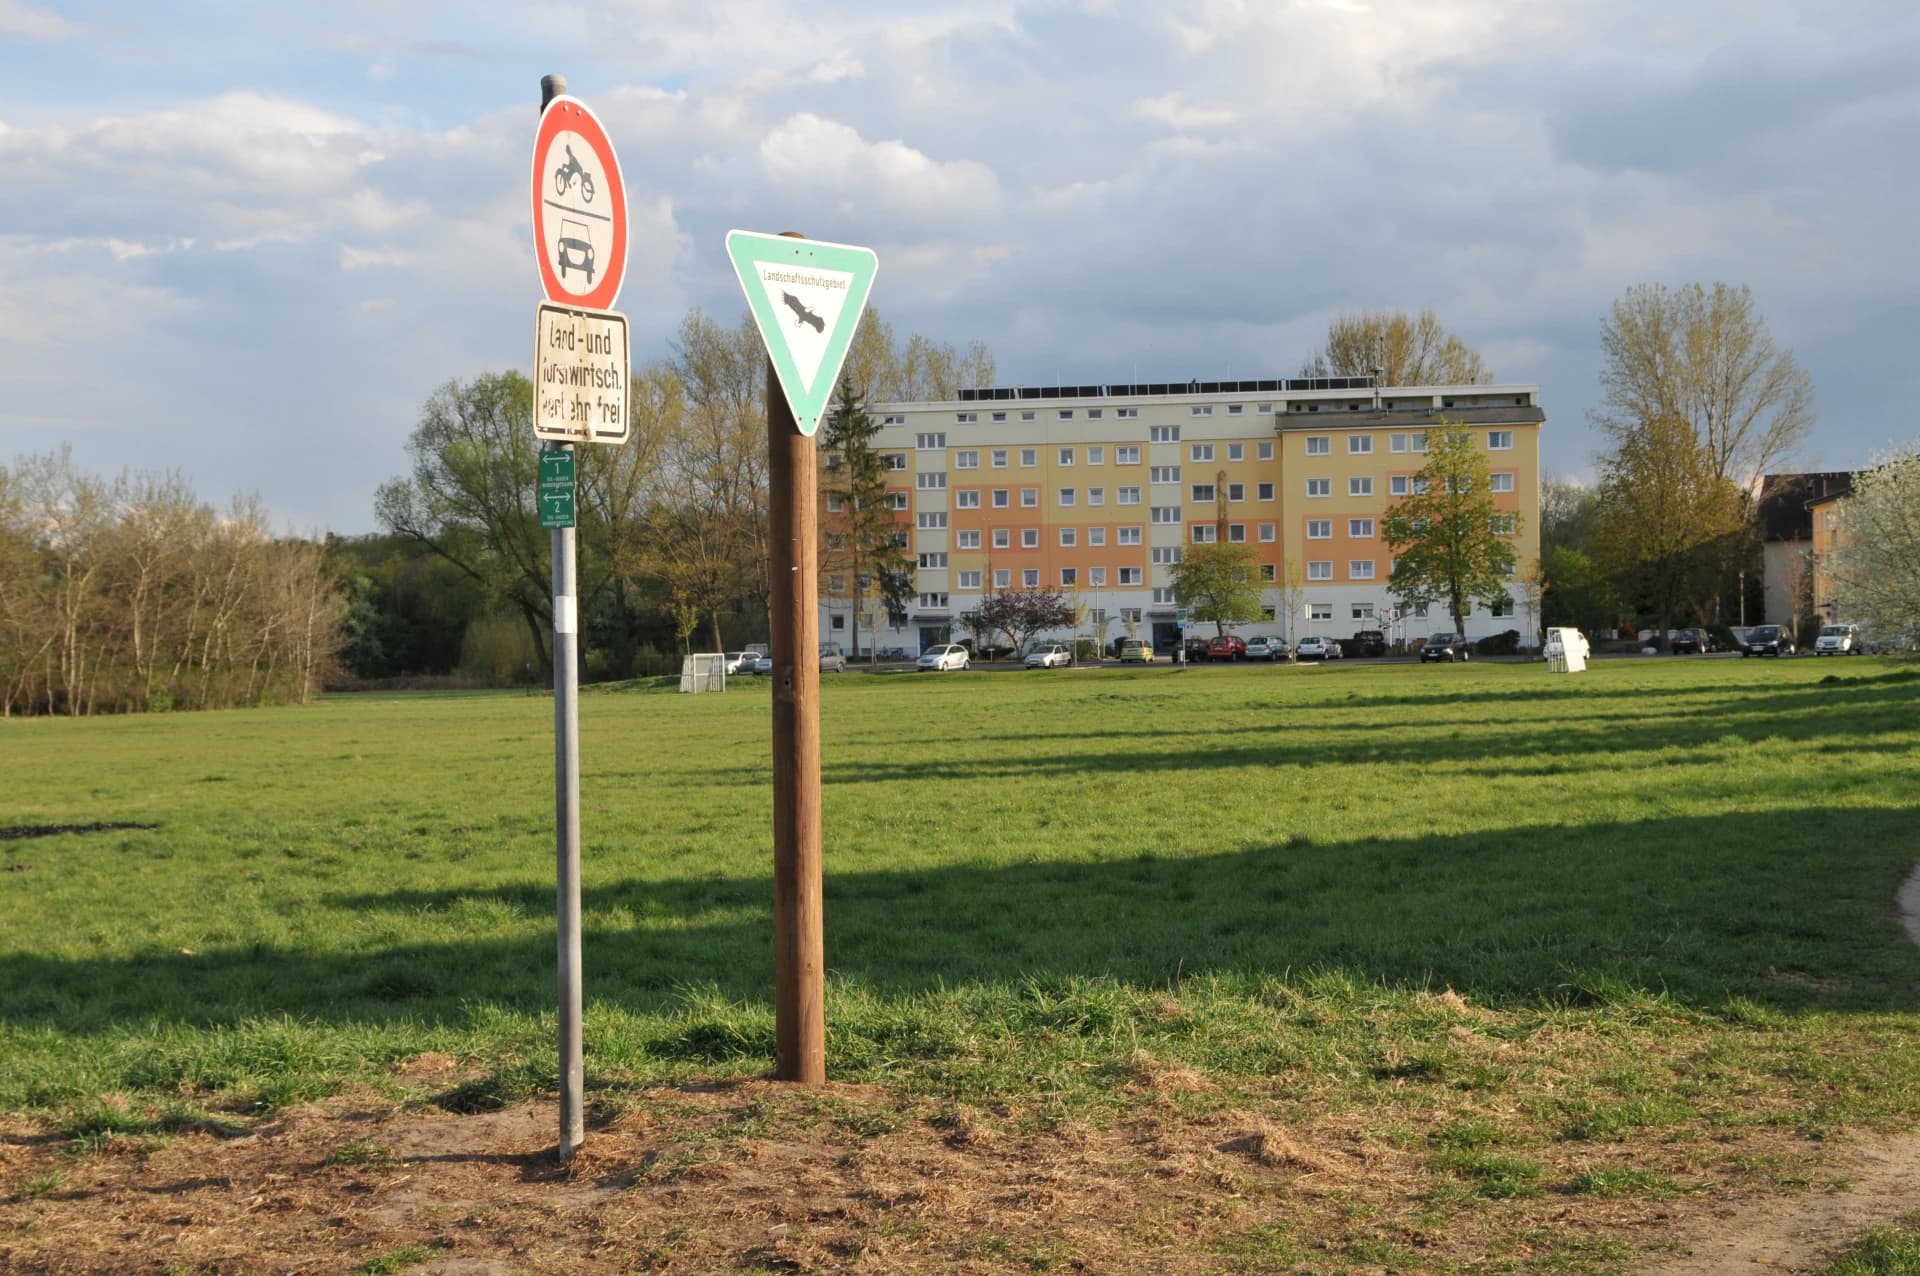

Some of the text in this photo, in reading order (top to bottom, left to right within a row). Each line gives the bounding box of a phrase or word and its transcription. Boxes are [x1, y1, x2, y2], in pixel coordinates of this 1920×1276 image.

[763, 270, 846, 289] Landschaftsschutzgebiet
[542, 389, 591, 422] erehr
[554, 463, 560, 475] 1
[554, 501, 561, 513] 2
